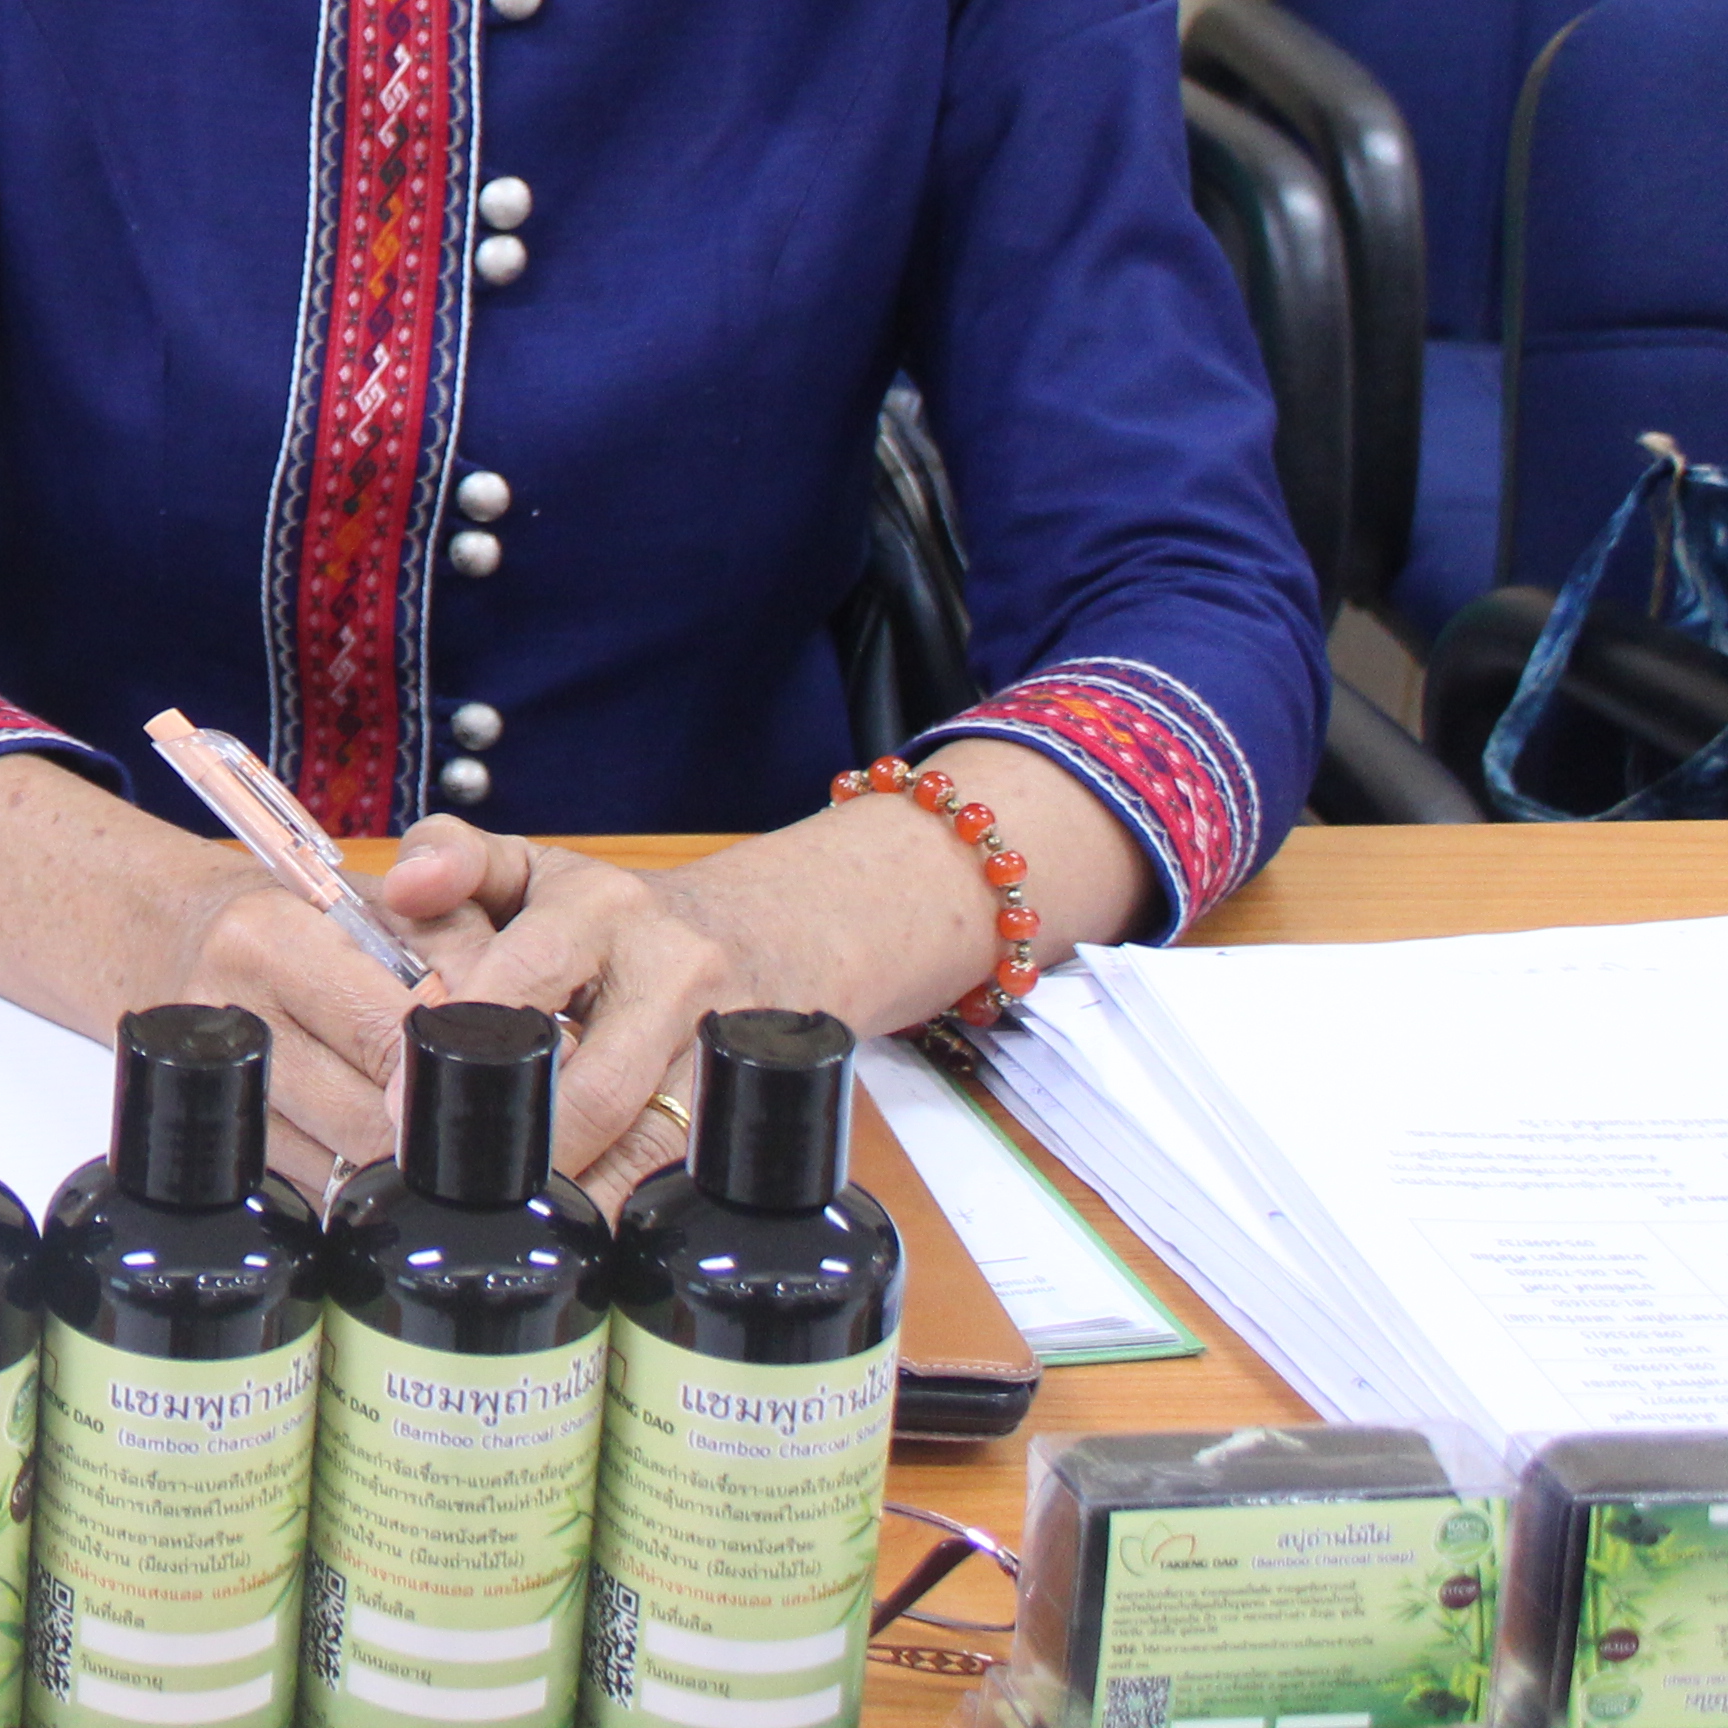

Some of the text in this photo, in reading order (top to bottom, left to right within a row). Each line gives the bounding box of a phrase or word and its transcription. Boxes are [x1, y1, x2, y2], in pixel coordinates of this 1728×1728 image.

[72, 1408, 105, 1434] DAO
[349, 1396, 380, 1423] DAO
[642, 1410, 676, 1436] DAO
[117, 1426, 200, 1455] (Bamboo
[207, 1429, 276, 1454] Charcoal
[393, 1417, 475, 1450] (Bamboo
[480, 1422, 555, 1452] Charcoal
[687, 1429, 772, 1460] (Bamboo
[779, 1433, 850, 1460] Charcoal
[1276, 1523, 1392, 1557] สบู่ถ่านไม้ไผ่
[1213, 1557, 1239, 1569] DAO
[1250, 1549, 1415, 1570] (Bamboo Charcoal Soap)
[83, 1594, 146, 1629] วันที่ผลิต
[354, 1586, 416, 1621] วันที่ผลิต
[649, 1600, 713, 1634] วันที่ผลิต
[79, 1653, 164, 1692] วันหมดอายุ
[351, 1642, 433, 1687] วันหมดอายุ
[646, 1658, 730, 1699] วันหมดอายุ
